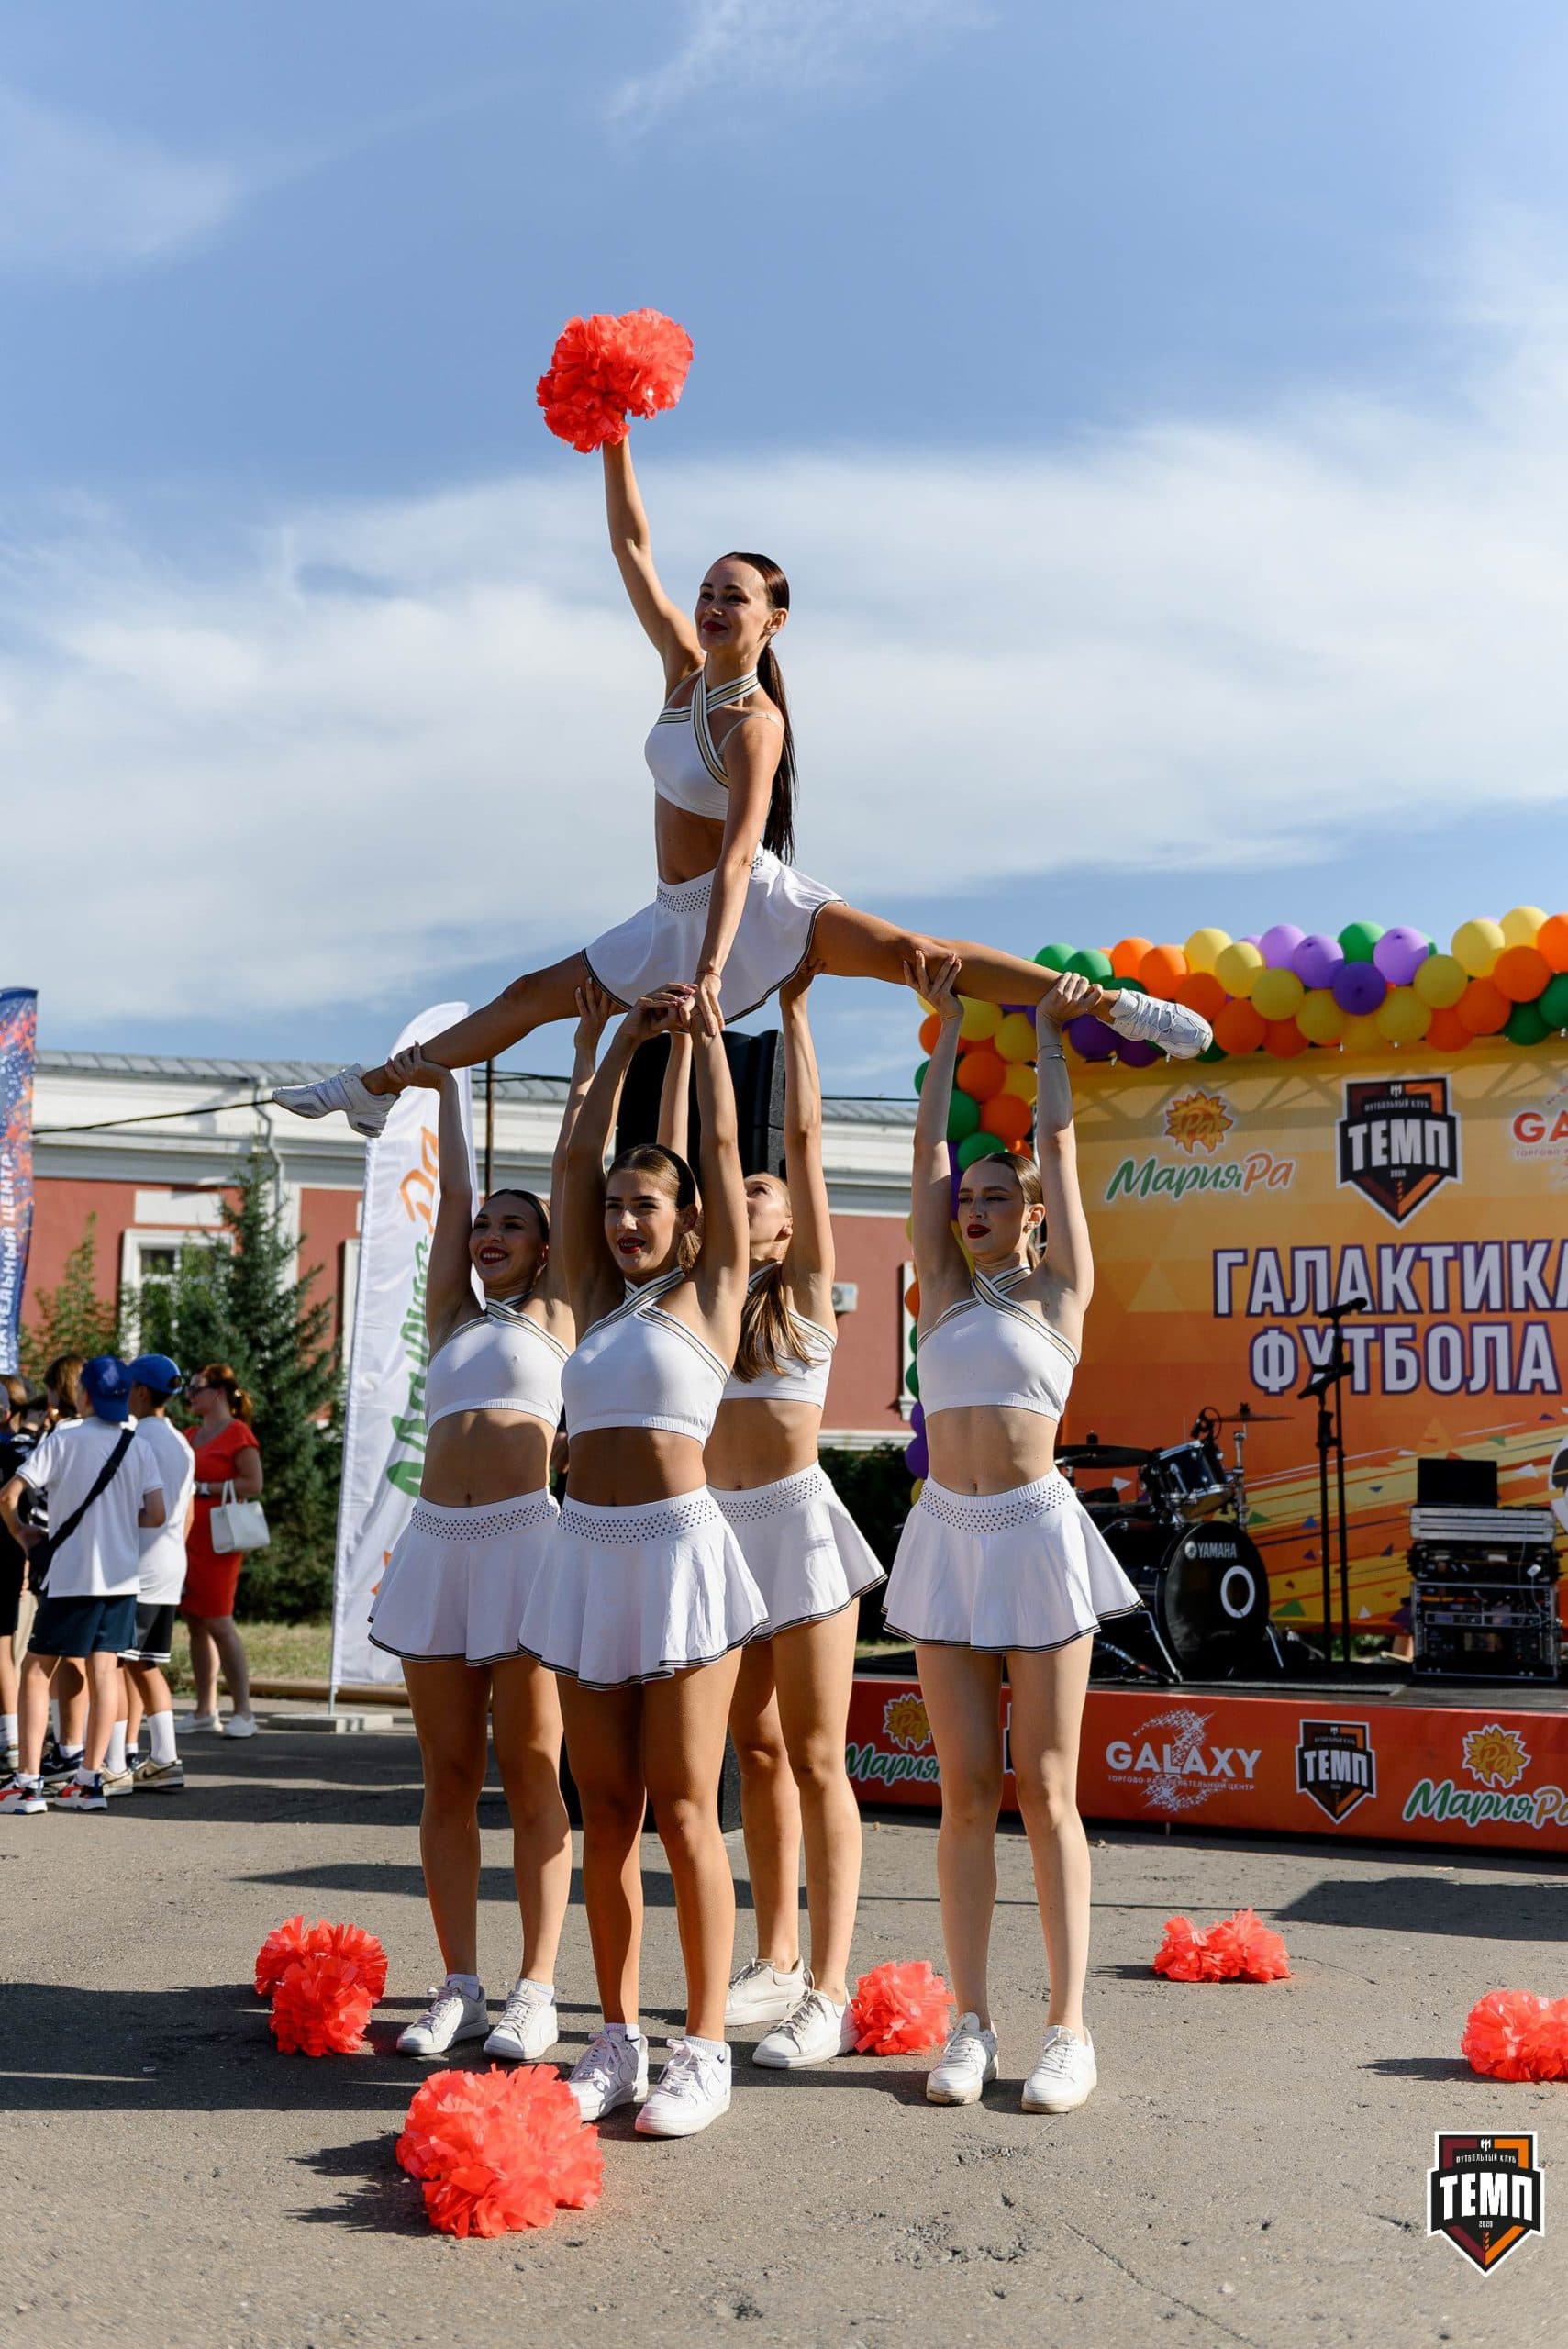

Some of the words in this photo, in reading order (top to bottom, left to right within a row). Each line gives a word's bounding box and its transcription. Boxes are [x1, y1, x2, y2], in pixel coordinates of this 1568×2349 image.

[1348, 1119, 1450, 1171] ТЕМП
[0, 1154, 16, 1221] ЦЕНТР
[0, 1227, 17, 1375] ЕКАТЕЛЬНЫЙ
[1250, 1321, 1562, 1396] ФУТБОЛА
[1197, 1542, 1238, 1558] YAMAHA
[1106, 1741, 1262, 1778] GALAXY
[1303, 1750, 1368, 1787] ТЕМП
